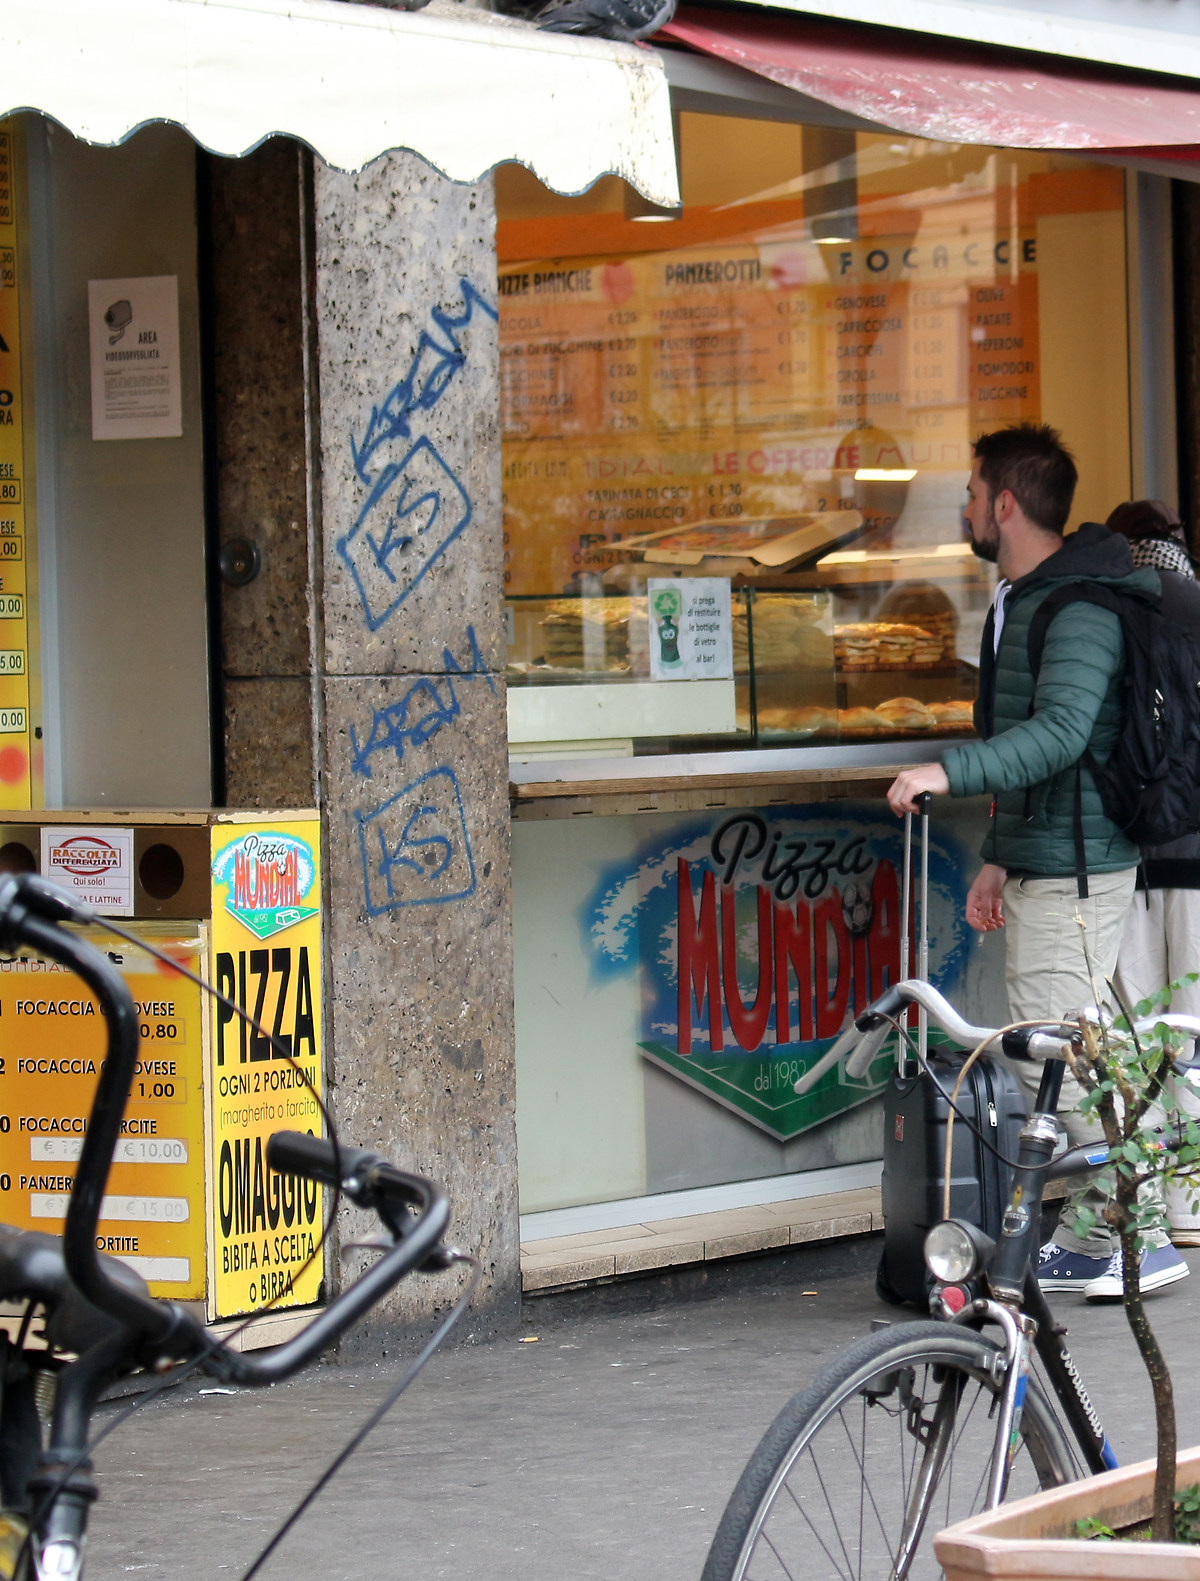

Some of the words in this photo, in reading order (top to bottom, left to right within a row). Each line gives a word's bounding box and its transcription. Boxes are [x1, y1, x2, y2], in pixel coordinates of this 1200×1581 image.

[840, 238, 1037, 276] FOCACCE
[665, 258, 760, 286] PANZEROTTI
[498, 274, 529, 295] IZZE
[534, 268, 592, 293] BIANCHE
[835, 294, 887, 310] GENOVESE
[976, 288, 1005, 303] OLIVE
[499, 318, 542, 331] UCOLA
[836, 320, 903, 334] CAPRICCIOSA
[976, 313, 1011, 326] PATATE
[138, 331, 158, 345] AREA
[977, 337, 1024, 353] PEPERONI
[105, 350, 159, 361] VIDEOSORVEGLIATA
[977, 361, 1034, 376] POMODORI
[978, 386, 1029, 401] ZUCCHINE
[712, 451, 739, 476] LE
[747, 444, 860, 475] OFFERTE
[588, 487, 643, 502] FARINATA
[694, 608, 721, 617] restituire
[696, 623, 720, 633] bottiglie
[701, 639, 717, 647] vetro
[52, 848, 118, 860] RACCOLTA
[243, 835, 288, 863] Pizza
[52, 858, 118, 867] DIFFERENZIATA
[710, 813, 875, 901] Pizza
[73, 877, 87, 886] Qui
[88, 878, 106, 886] solo!
[234, 847, 301, 911] MUNDIAL
[95, 896, 122, 904] LATTINE
[17, 1000, 95, 1016] FOCACCIA
[216, 946, 317, 1066] PIZZA
[140, 1024, 177, 1039] 0,80
[18, 1059, 96, 1074] FOCACCIA
[219, 1073, 251, 1097] OGNI
[254, 1072, 261, 1094] 2
[264, 1066, 317, 1092] PORZIONI
[754, 1063, 772, 1092] dal
[220, 1102, 276, 1130] (margherita
[278, 1104, 285, 1118] o
[286, 1096, 320, 1118] farcita)
[19, 1117, 87, 1132] FOCACCI
[119, 1119, 157, 1134] RCITE
[20, 1175, 73, 1190] PANZER
[219, 1128, 317, 1239] OMAGGIO
[223, 1239, 258, 1274] BIBITA
[262, 1243, 271, 1267] A
[274, 1232, 316, 1264] SCELTA
[250, 1282, 257, 1303] o
[261, 1269, 294, 1302] BIRRA
